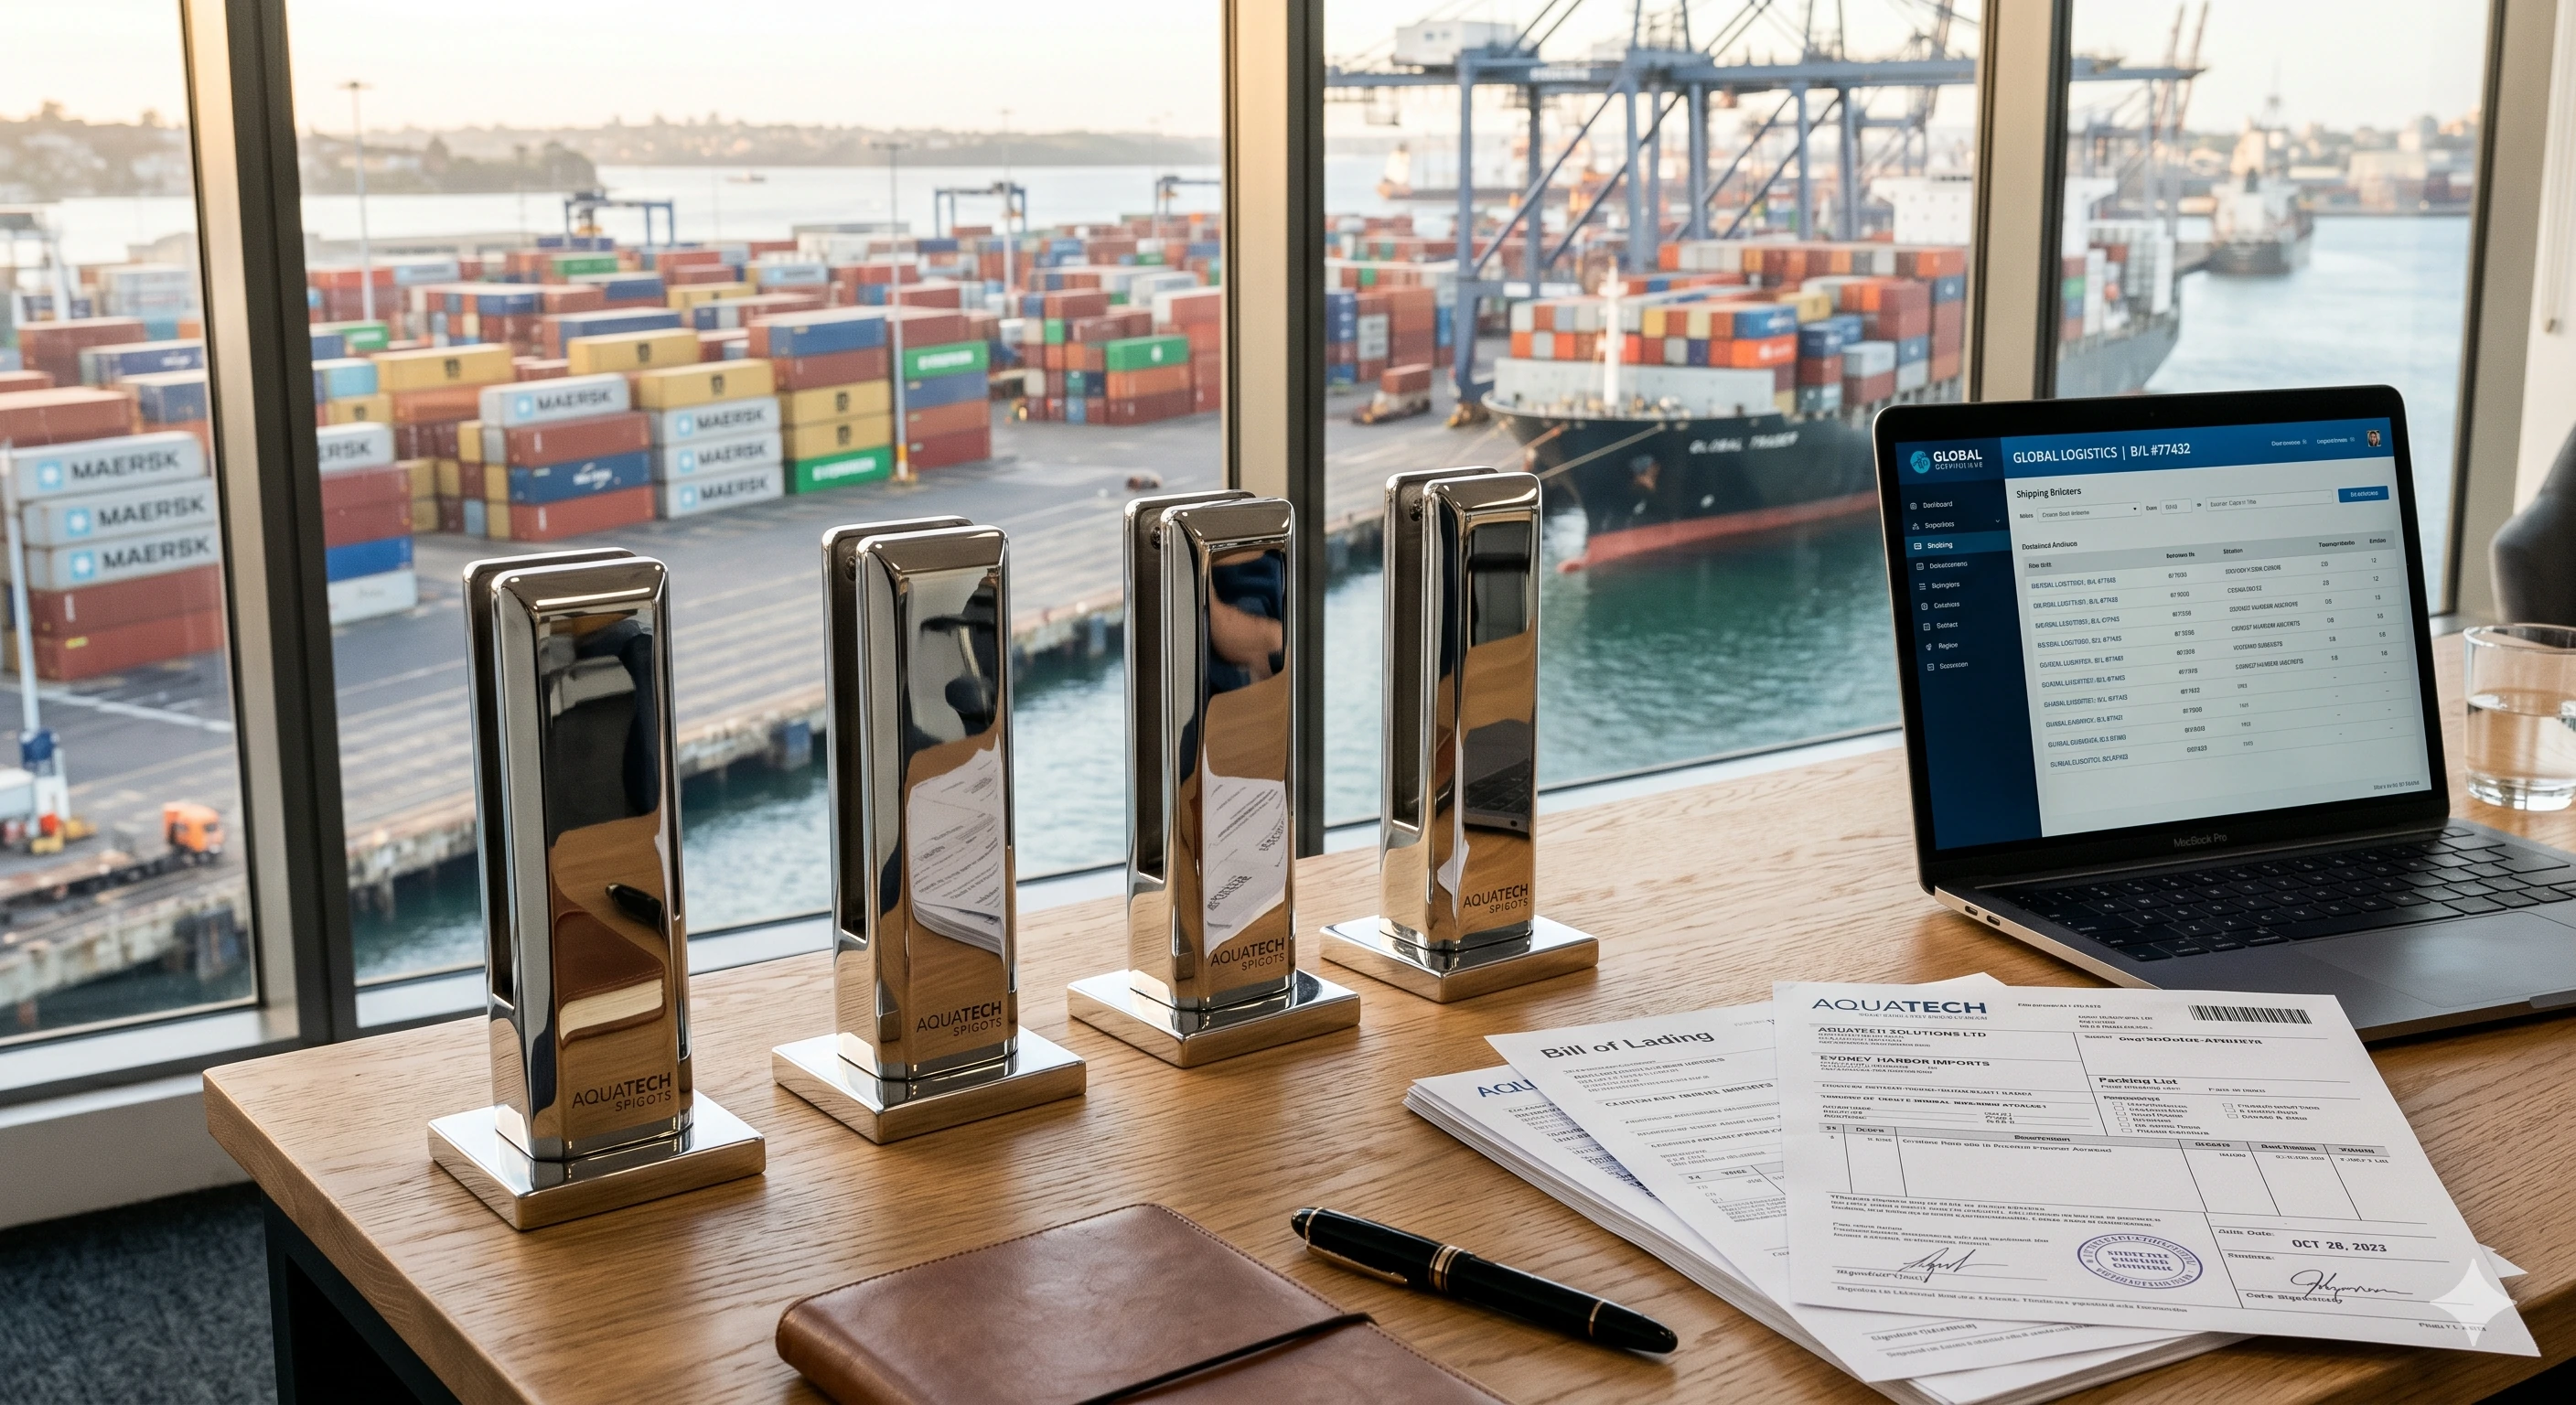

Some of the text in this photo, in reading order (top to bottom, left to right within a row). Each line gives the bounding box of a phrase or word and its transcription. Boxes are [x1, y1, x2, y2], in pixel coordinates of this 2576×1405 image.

[536, 388, 613, 411] MAERSK
[696, 407, 766, 431] MAERSK
[71, 449, 180, 479] MAERSK
[699, 440, 767, 465] MAERSK
[1933, 448, 1982, 463] GLOBAL
[2012, 450, 2059, 464] GLOBAL
[2060, 446, 2118, 461] LOGISTICS
[2130, 445, 2150, 457] B/L
[2151, 443, 2191, 456] #77432
[700, 473, 770, 500] MAERSK
[2016, 488, 2049, 500] Shipping
[97, 493, 206, 527] MAERSK
[102, 536, 210, 570] MAERSK
[2214, 833, 2227, 842] Pro
[1464, 884, 1529, 908] AQUATECH
[1210, 937, 1285, 968] AQUATECH
[1241, 953, 1285, 971] SPIGOTS
[916, 1000, 1002, 1034] AQUATECH
[1811, 998, 1987, 1014] AQUATECH
[953, 1016, 1002, 1036] SPIGOTS
[1540, 1031, 1715, 1059] Bill of Lading
[1877, 1056, 1930, 1065] HARBOR
[1932, 1058, 1991, 1067] IMPORTS
[572, 1072, 671, 1110] AQUATECH
[615, 1089, 671, 1112] SPIGOTS
[2292, 1239, 2321, 1249] OCT
[2351, 1242, 2388, 1253] 2023
